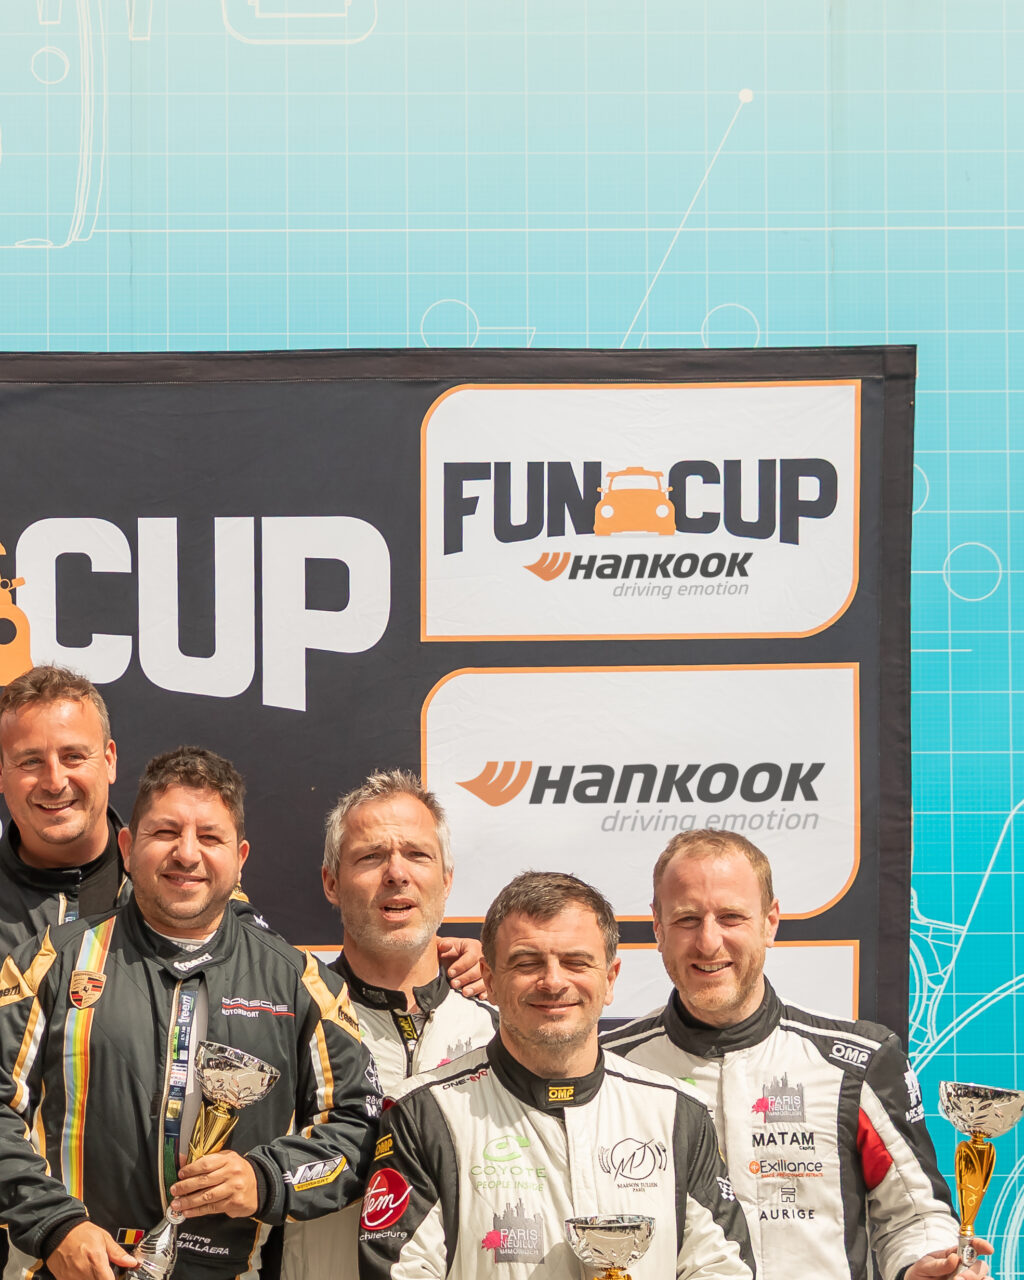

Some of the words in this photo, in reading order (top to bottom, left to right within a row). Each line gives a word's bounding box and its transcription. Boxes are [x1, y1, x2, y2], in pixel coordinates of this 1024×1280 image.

[443, 461, 602, 556] FUN
[668, 458, 838, 546] CUP
[612, 581, 674, 600] driving
[678, 582, 750, 597] emotion
[15, 515, 391, 711] CUP
[600, 809, 697, 833] driving
[705, 808, 820, 831] emotion
[831, 1044, 870, 1065] OMP
[548, 1088, 575, 1099] OMP
[767, 1095, 801, 1105] PARIS
[751, 1131, 815, 1147] MATAM
[471, 1165, 547, 1178] COYOTE
[477, 1180, 511, 1190] PEOPLE
[759, 1208, 816, 1221] AURIGE
[499, 1228, 538, 1241] PARIS
[499, 1239, 538, 1250] NEUILLY
